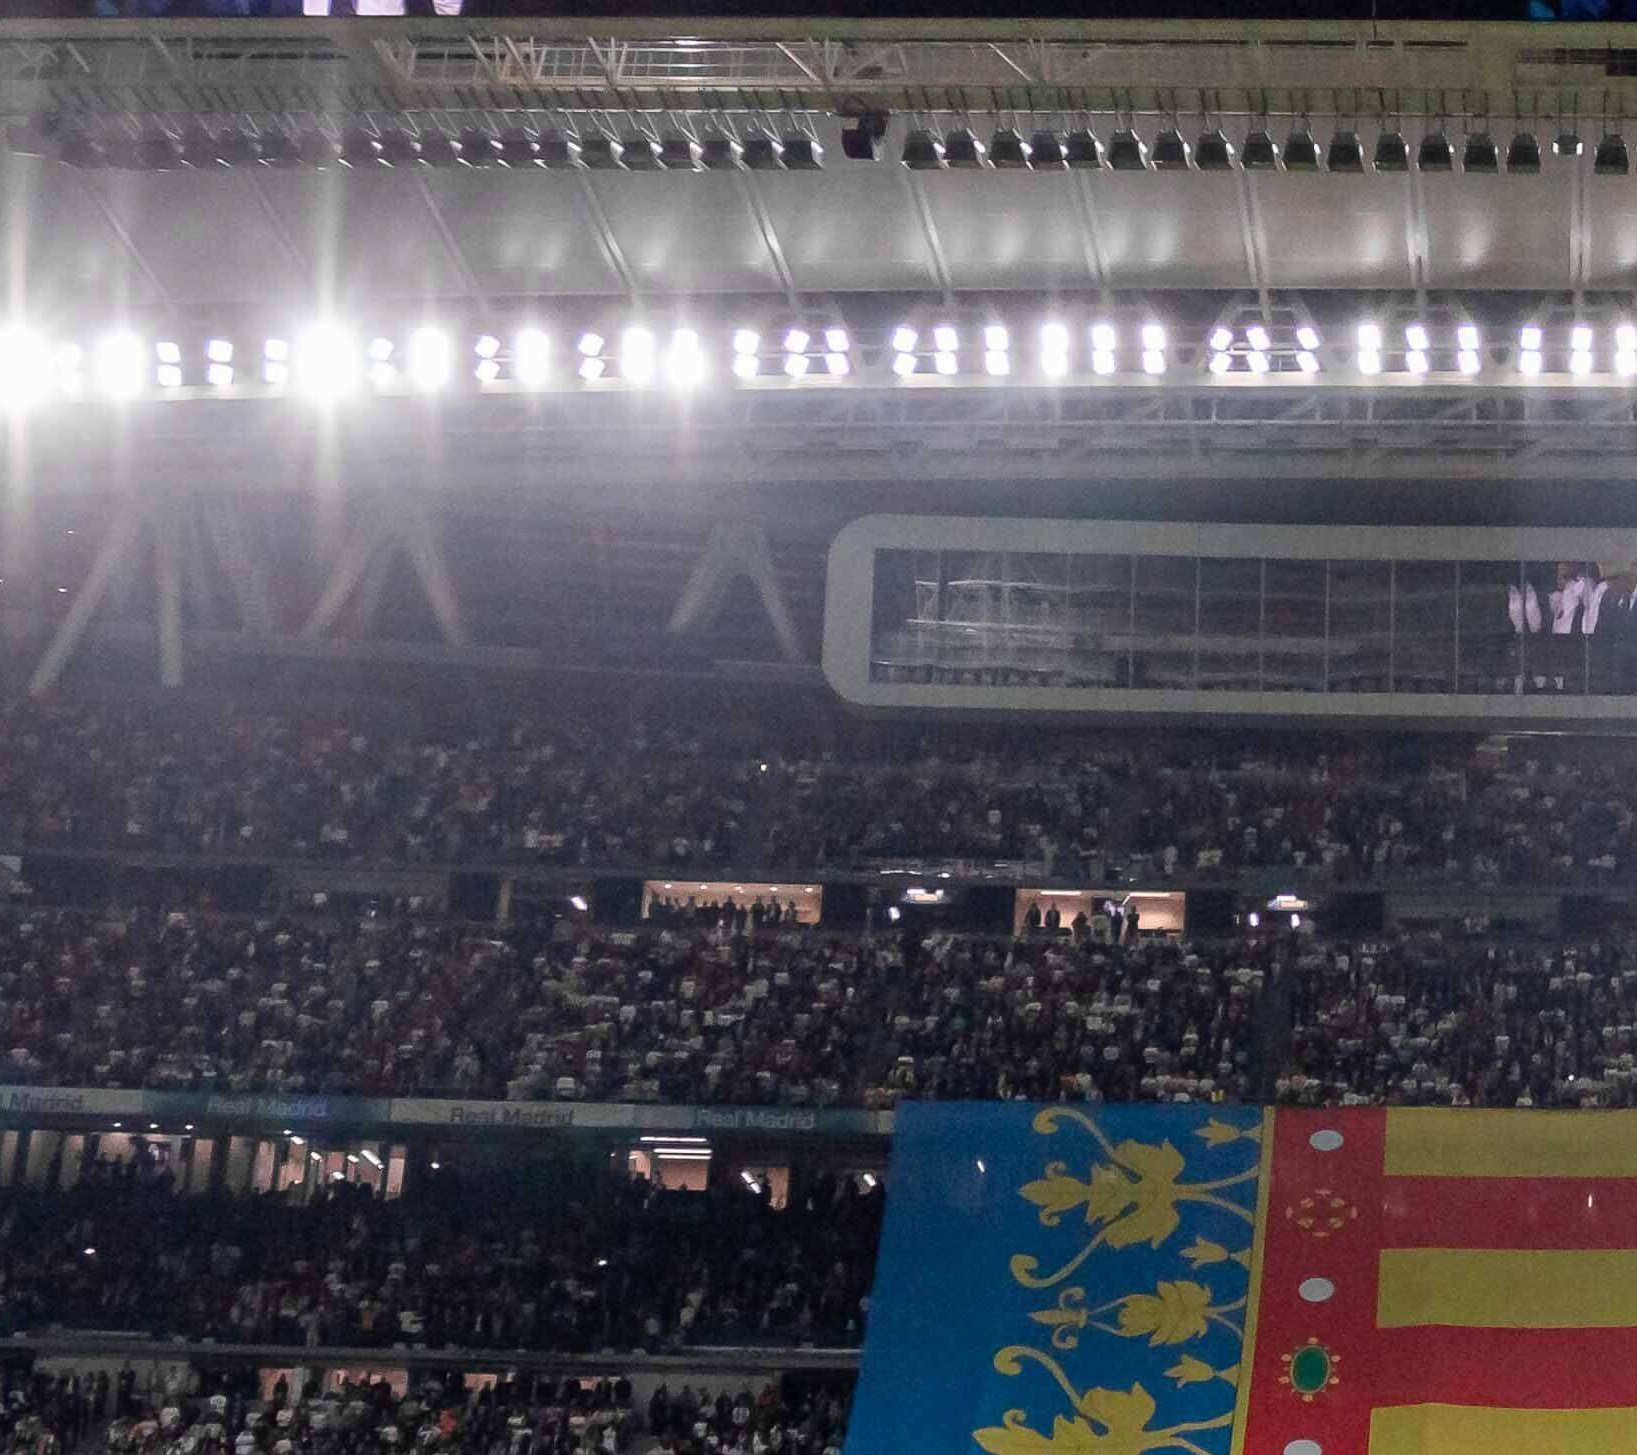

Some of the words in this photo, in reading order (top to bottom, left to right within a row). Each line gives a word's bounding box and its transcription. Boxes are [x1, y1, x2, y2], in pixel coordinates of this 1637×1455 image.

[9, 1093, 84, 1111] Madrid
[207, 1096, 252, 1115] Real
[258, 1098, 327, 1117] Madrid
[449, 1106, 500, 1124] Real
[504, 1107, 573, 1125] Madrid
[698, 1109, 740, 1127] Real
[745, 1111, 814, 1129] Madrid
